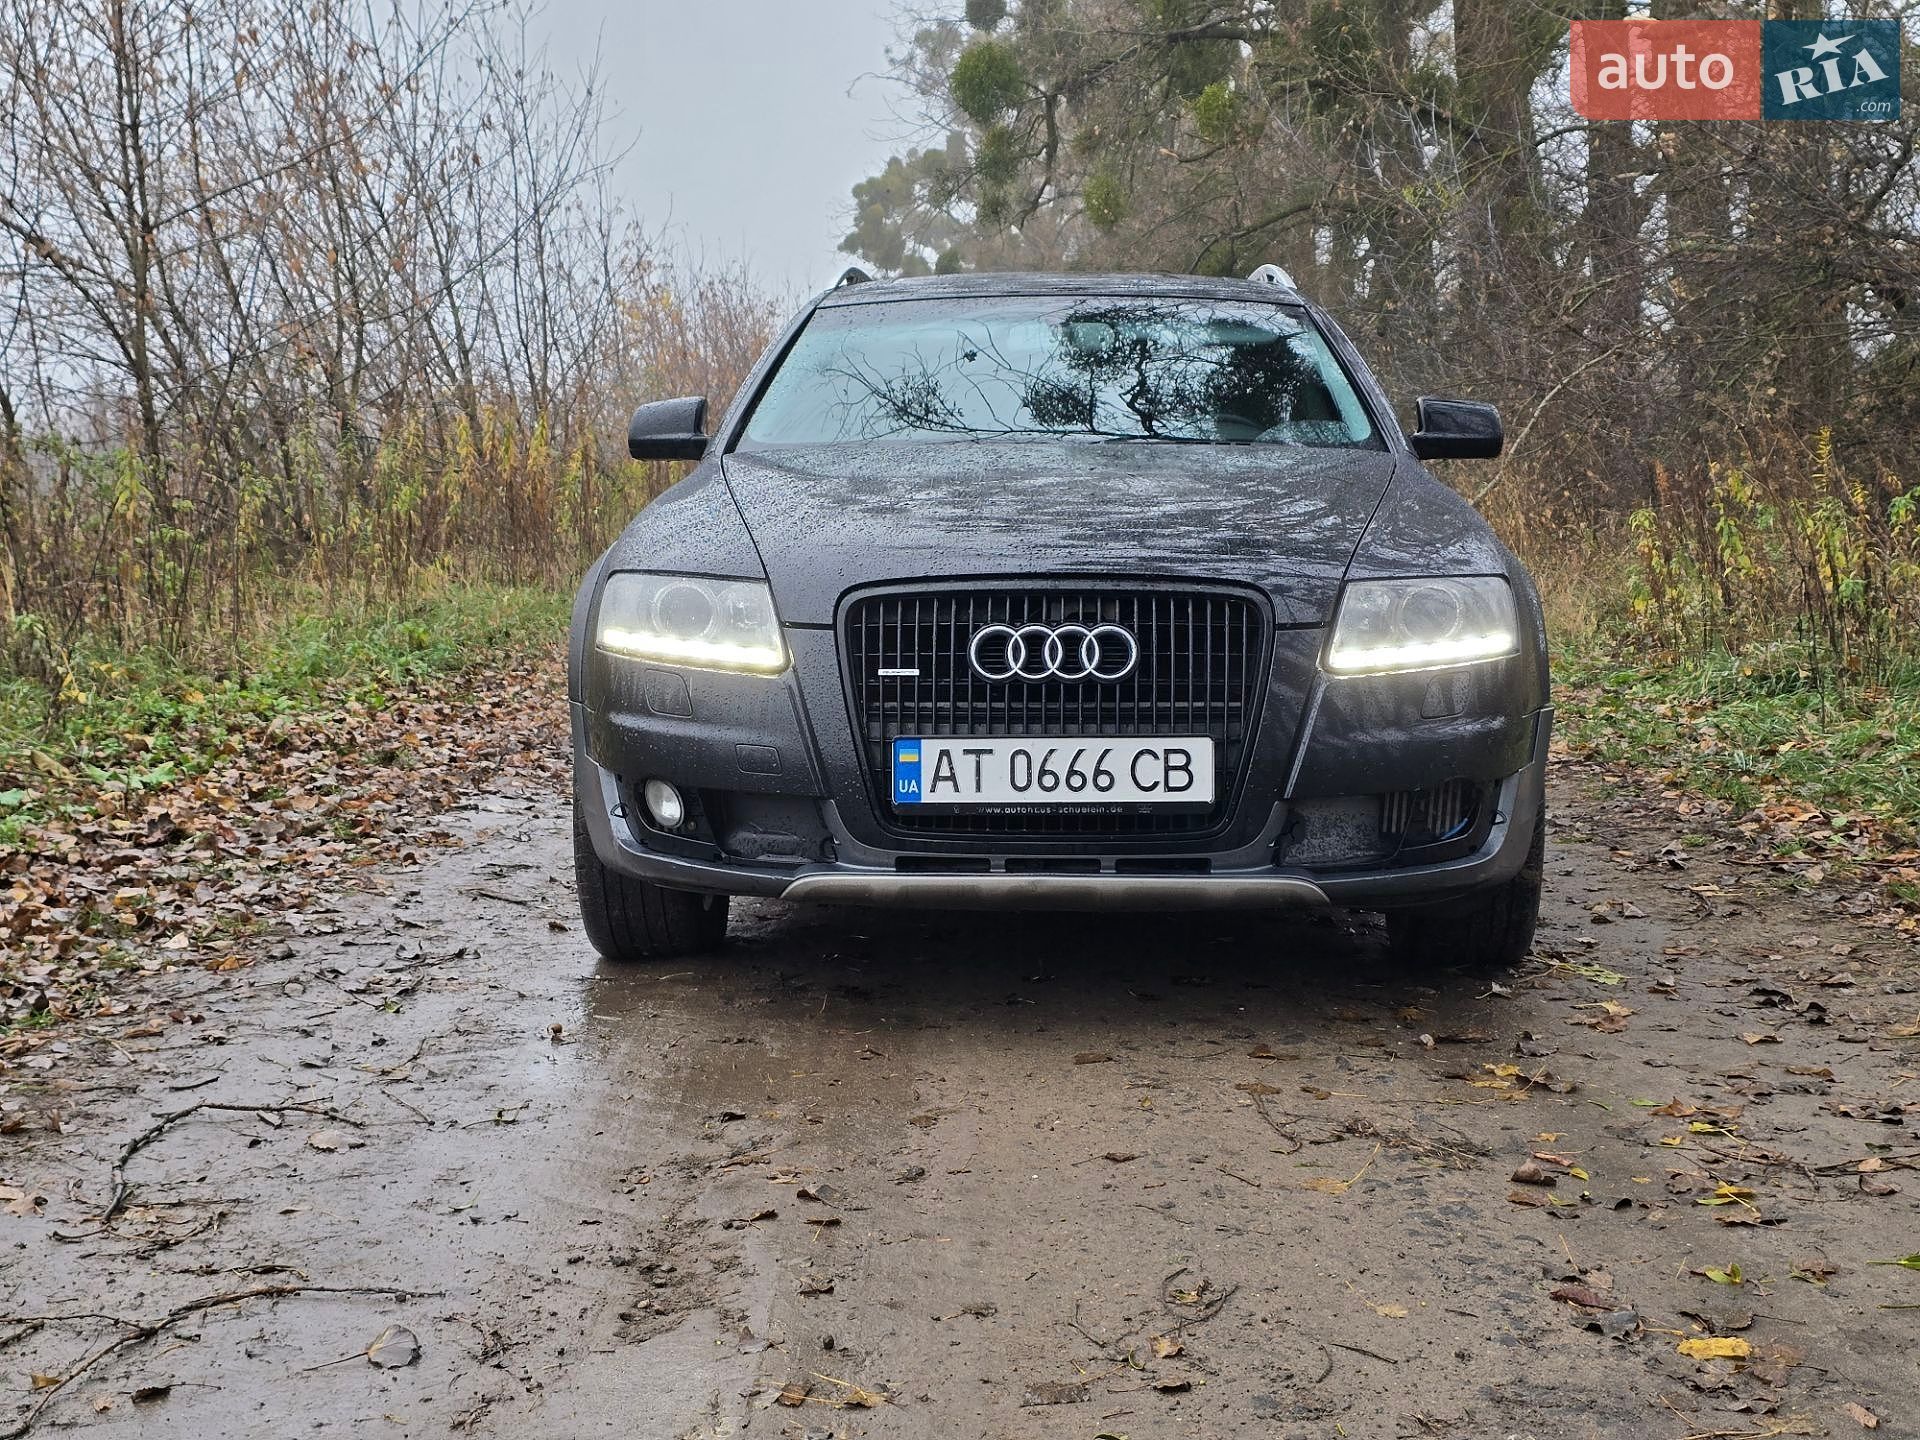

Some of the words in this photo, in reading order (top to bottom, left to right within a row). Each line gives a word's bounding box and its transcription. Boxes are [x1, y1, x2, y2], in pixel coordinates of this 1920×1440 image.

[929, 748, 994, 793] AT
[1009, 748, 1116, 793] 0666
[1129, 748, 1194, 793] CB
[899, 780, 919, 793] UA
